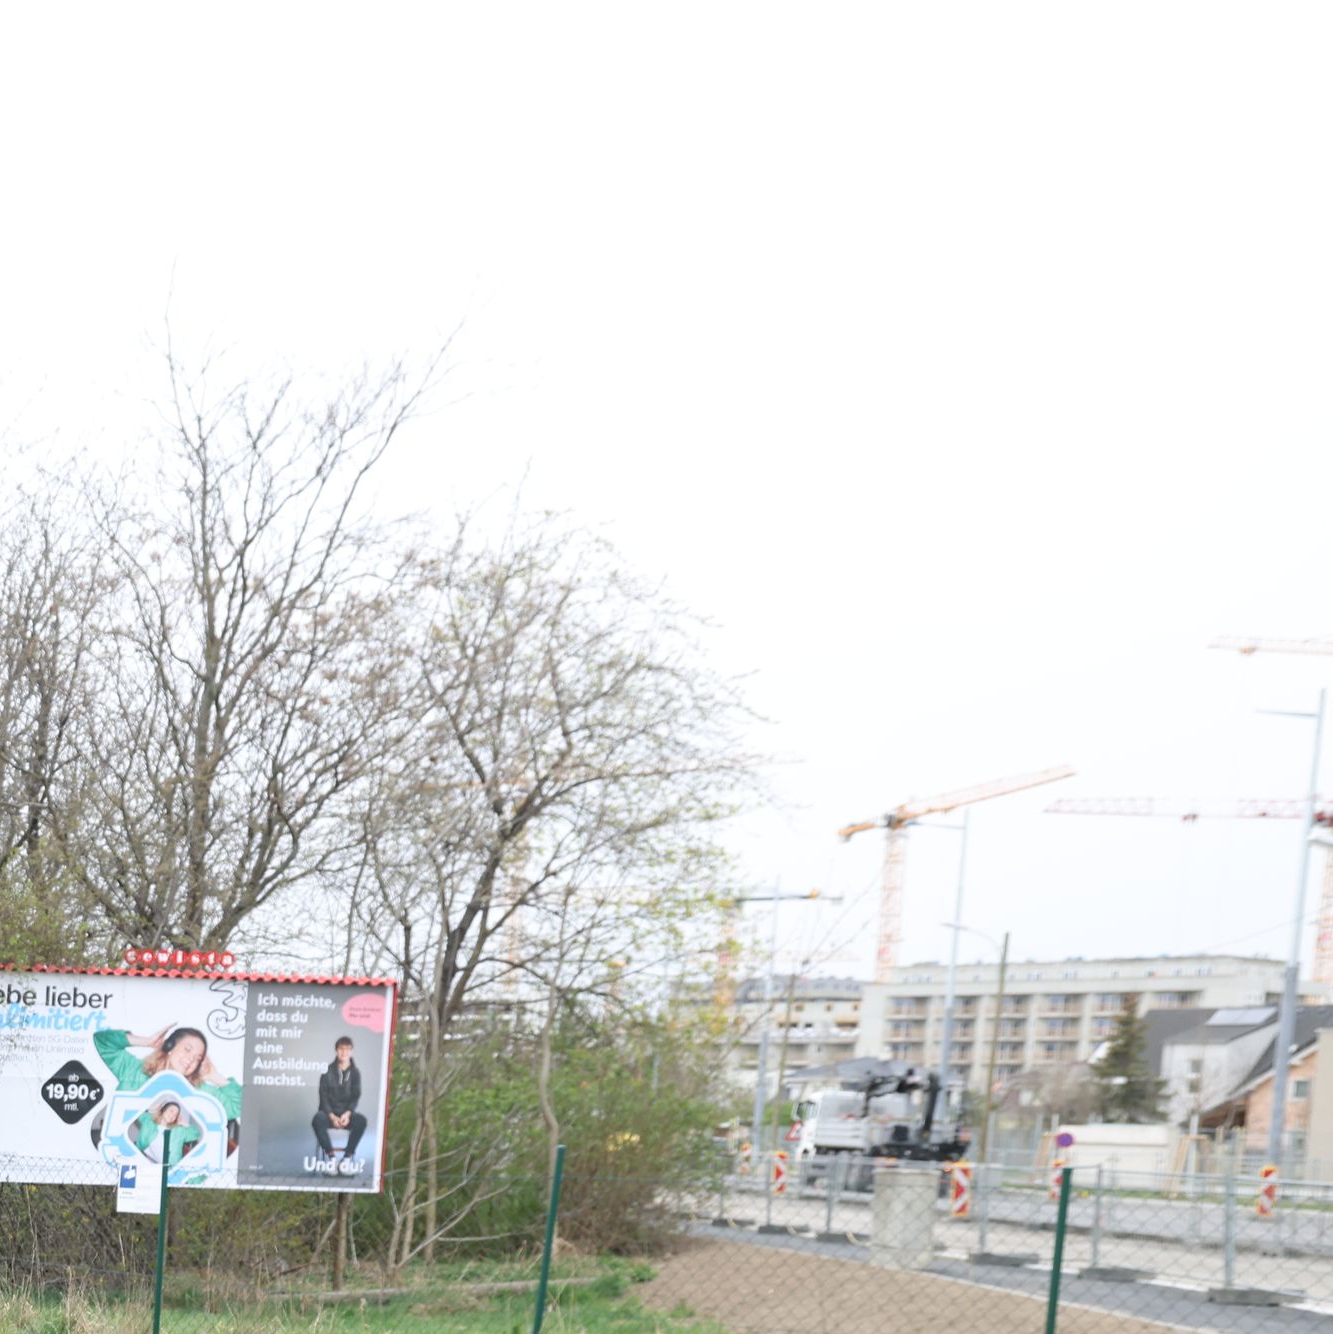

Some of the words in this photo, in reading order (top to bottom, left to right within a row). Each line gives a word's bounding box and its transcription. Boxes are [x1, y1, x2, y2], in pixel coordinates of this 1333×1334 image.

[44, 985, 113, 1009] lieber
[257, 992, 279, 1007] Ich
[282, 993, 337, 1010] möchte,
[256, 1010, 287, 1023] dass
[290, 1010, 309, 1024] du
[255, 1026, 278, 1039] mit
[281, 1026, 303, 1040] mir
[254, 1040, 284, 1054] eine
[252, 1056, 329, 1075] Ausbildung
[253, 1073, 306, 1087] machst.
[302, 1155, 337, 1174] Und
[339, 1157, 366, 1174] du?
